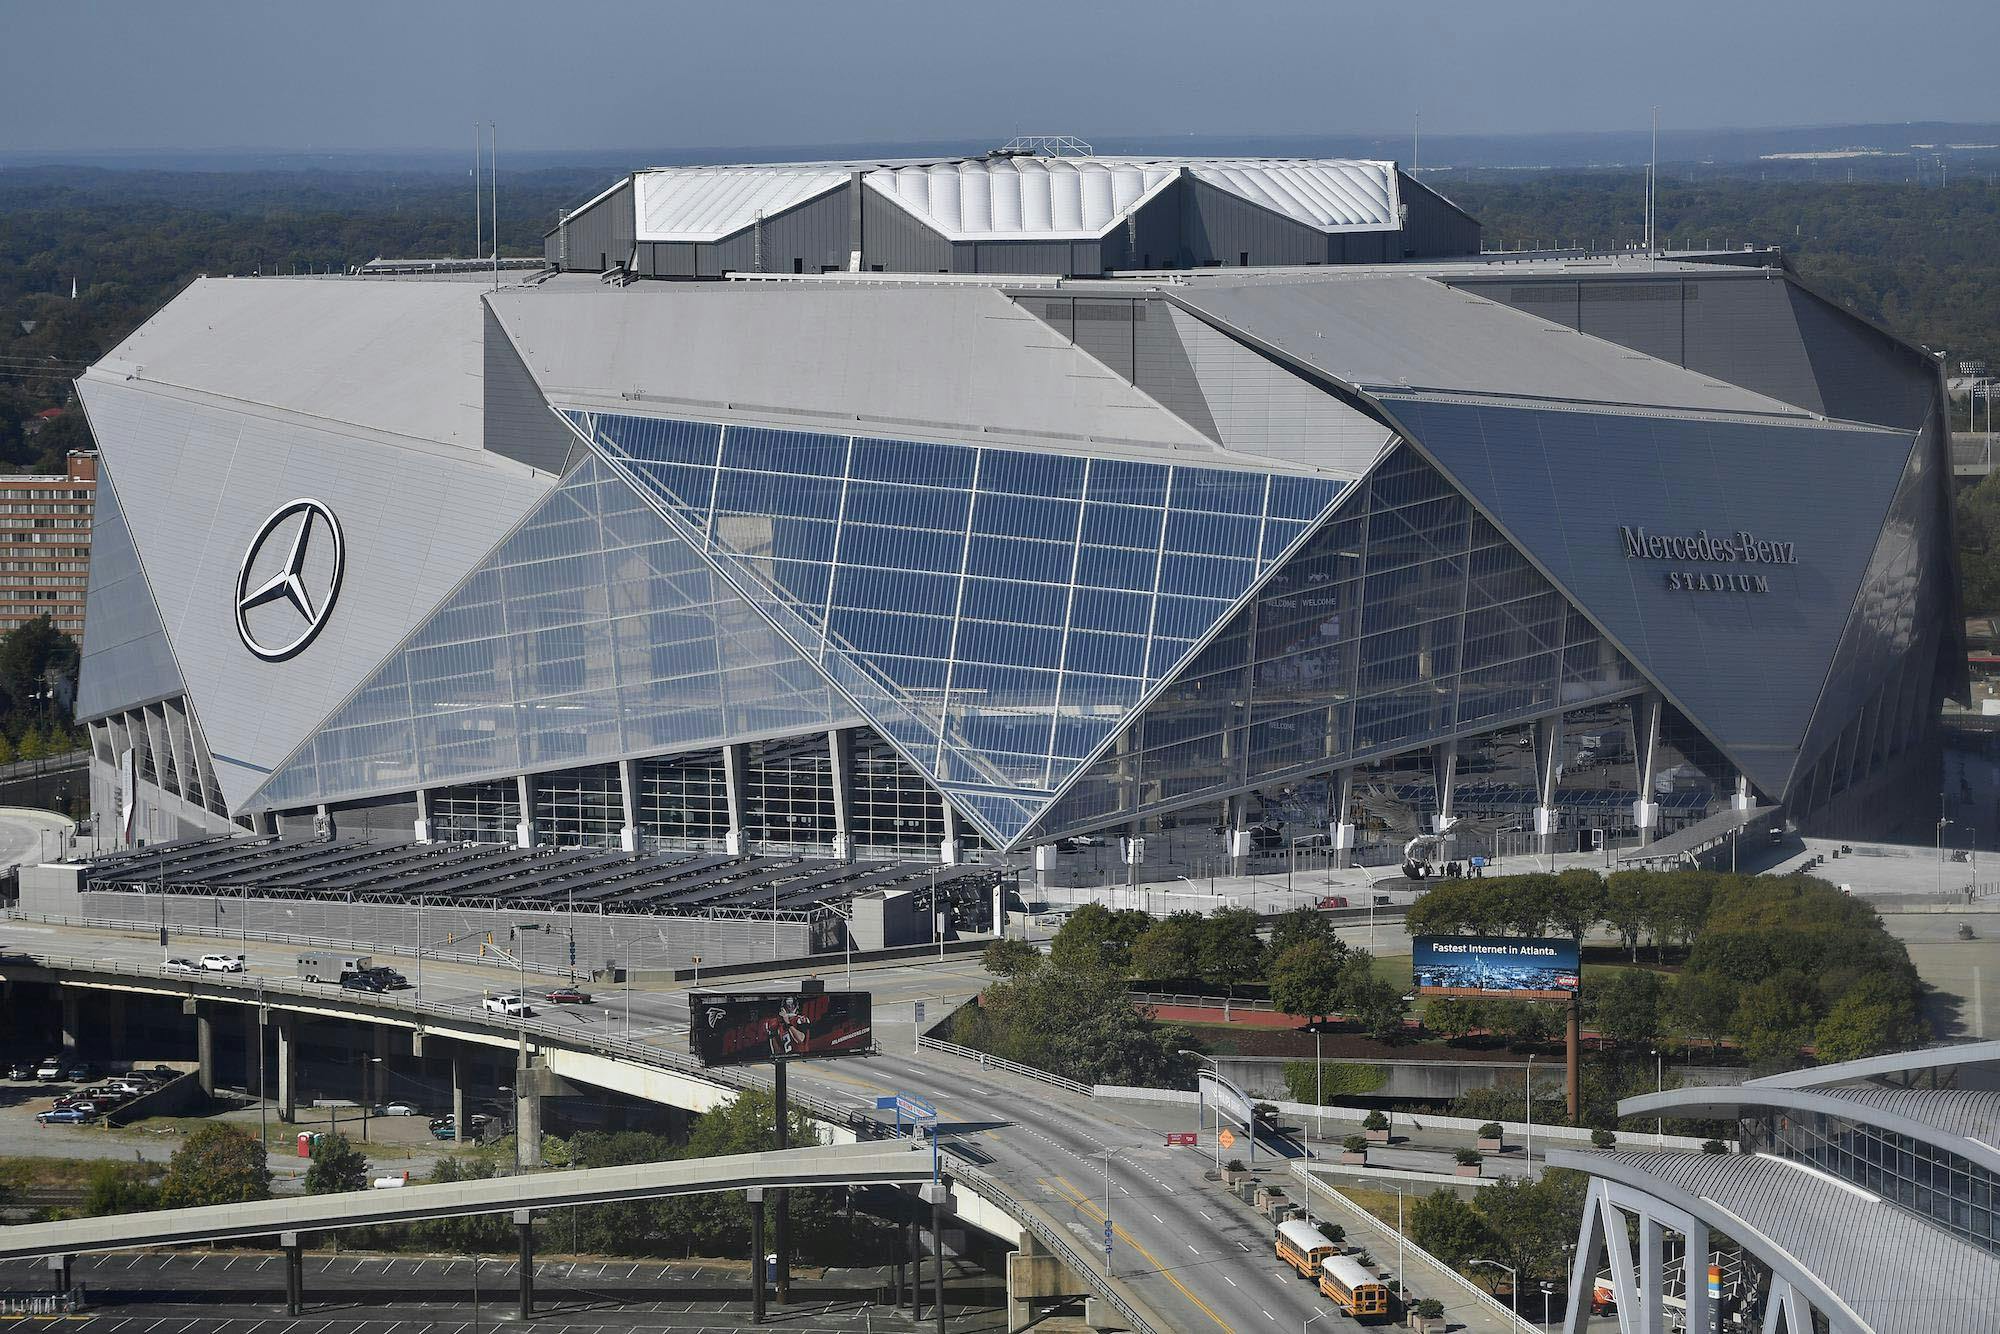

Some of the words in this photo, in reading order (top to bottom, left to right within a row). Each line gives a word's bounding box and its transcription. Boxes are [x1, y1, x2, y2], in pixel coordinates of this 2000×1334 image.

[1621, 525, 1798, 564] Mercedes-Benz
[1670, 571, 1770, 593] STADIUM
[1303, 598, 1336, 607] WELCOME
[1433, 943, 1467, 953] Fastest
[1469, 944, 1507, 954] Internet
[1509, 944, 1518, 954] in
[1520, 945, 1557, 956] Atlanta.
